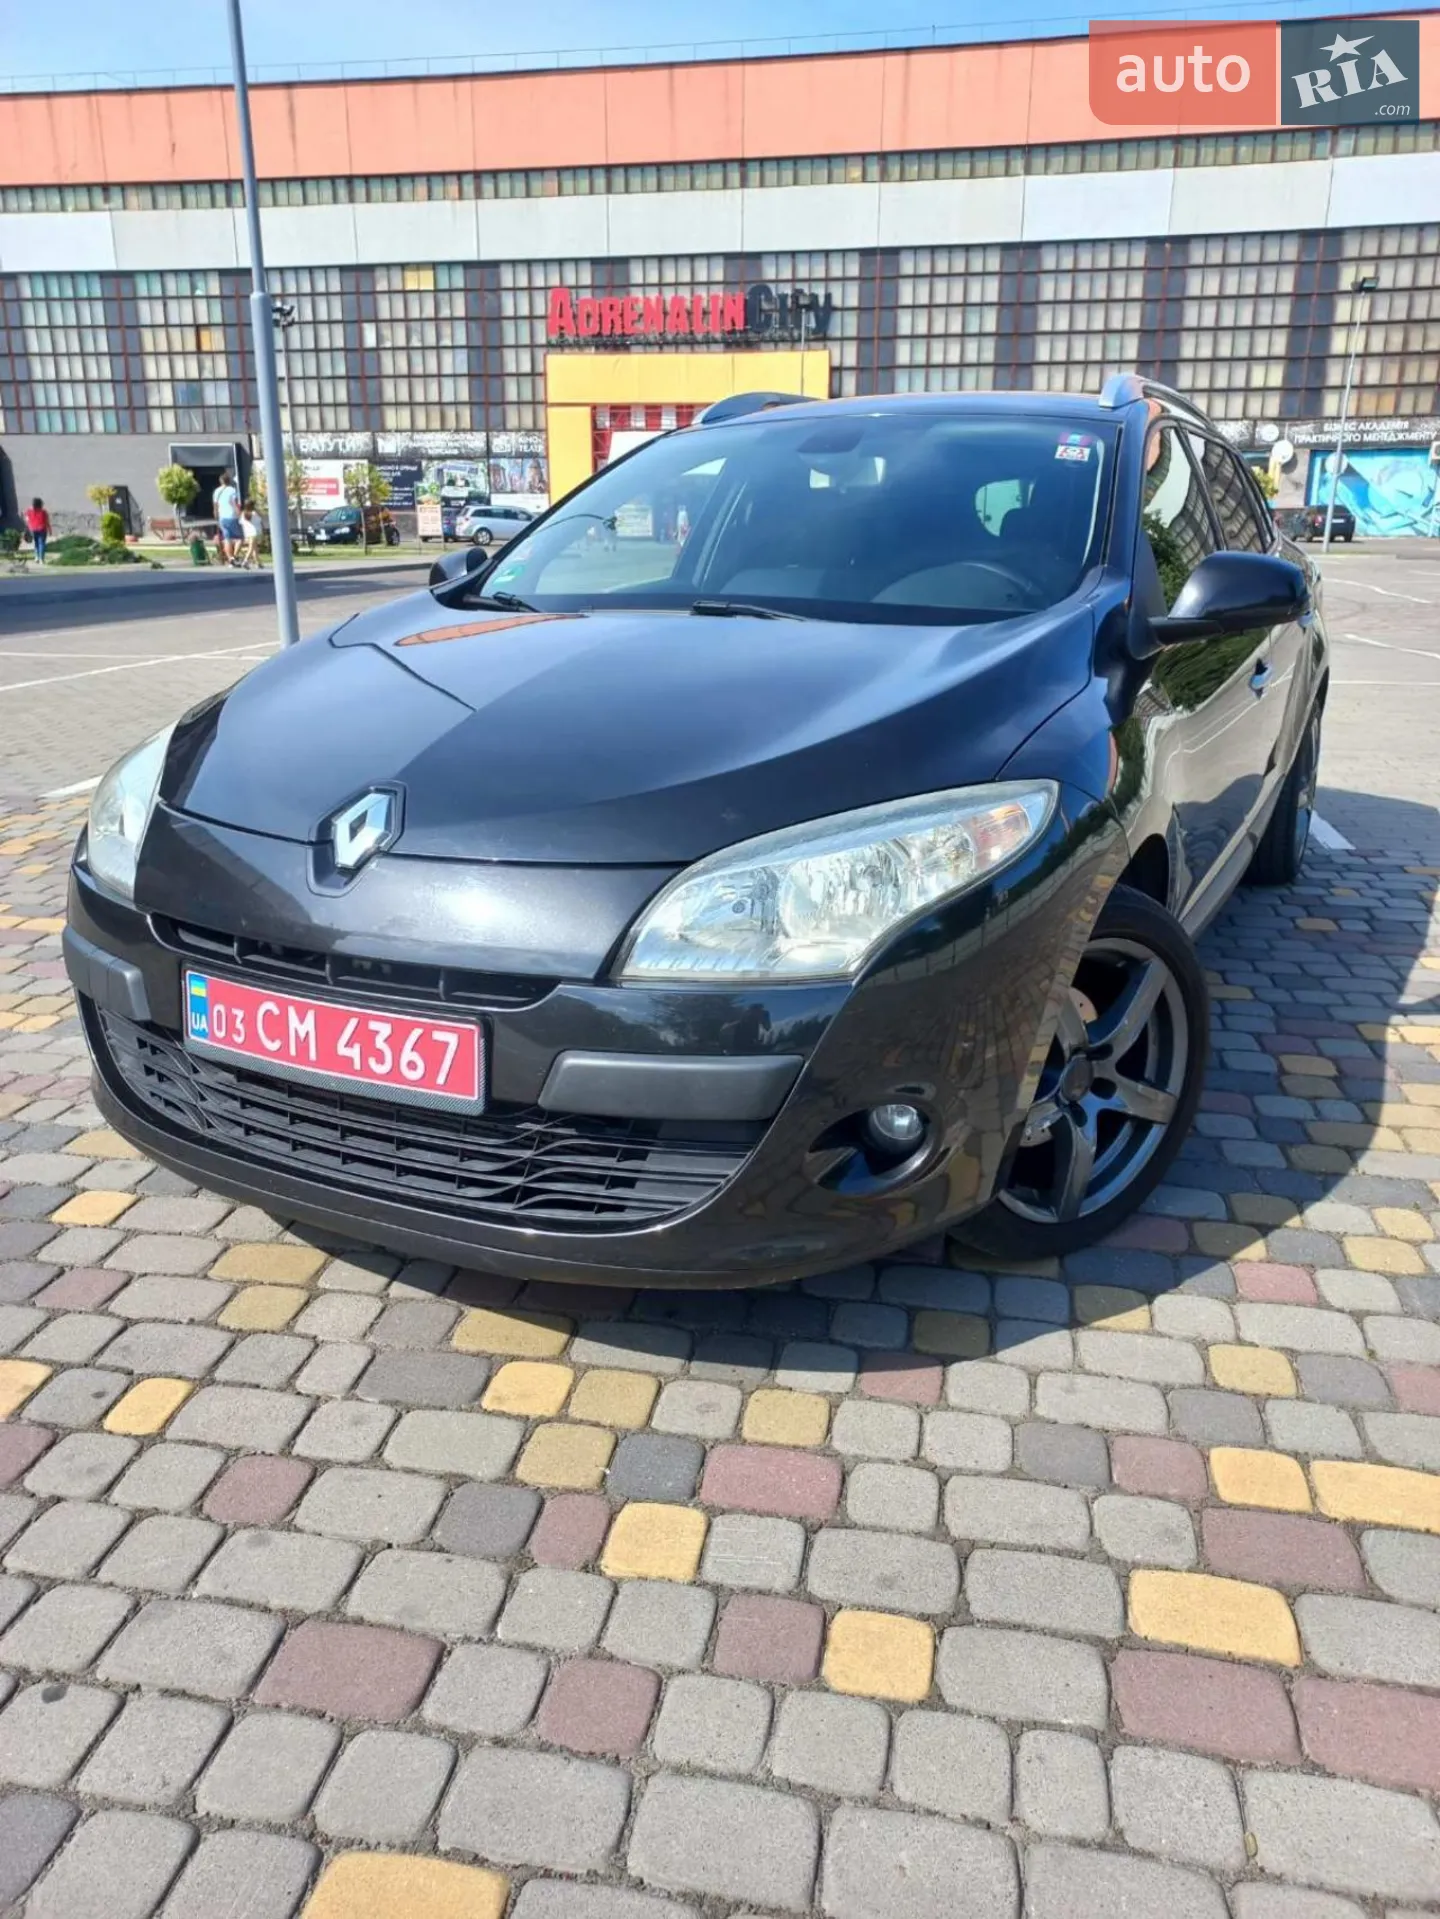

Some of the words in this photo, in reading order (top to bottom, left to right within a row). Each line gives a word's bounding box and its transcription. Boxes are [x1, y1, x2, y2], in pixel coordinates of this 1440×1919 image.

[547, 287, 747, 337] ADRENALIN
[1363, 430, 1438, 442] МЕНЕДЖМЕНТУ
[191, 1012, 209, 1034] UA
[213, 1003, 246, 1044] 03
[256, 1001, 318, 1062] CM
[336, 1016, 459, 1086] 4367
